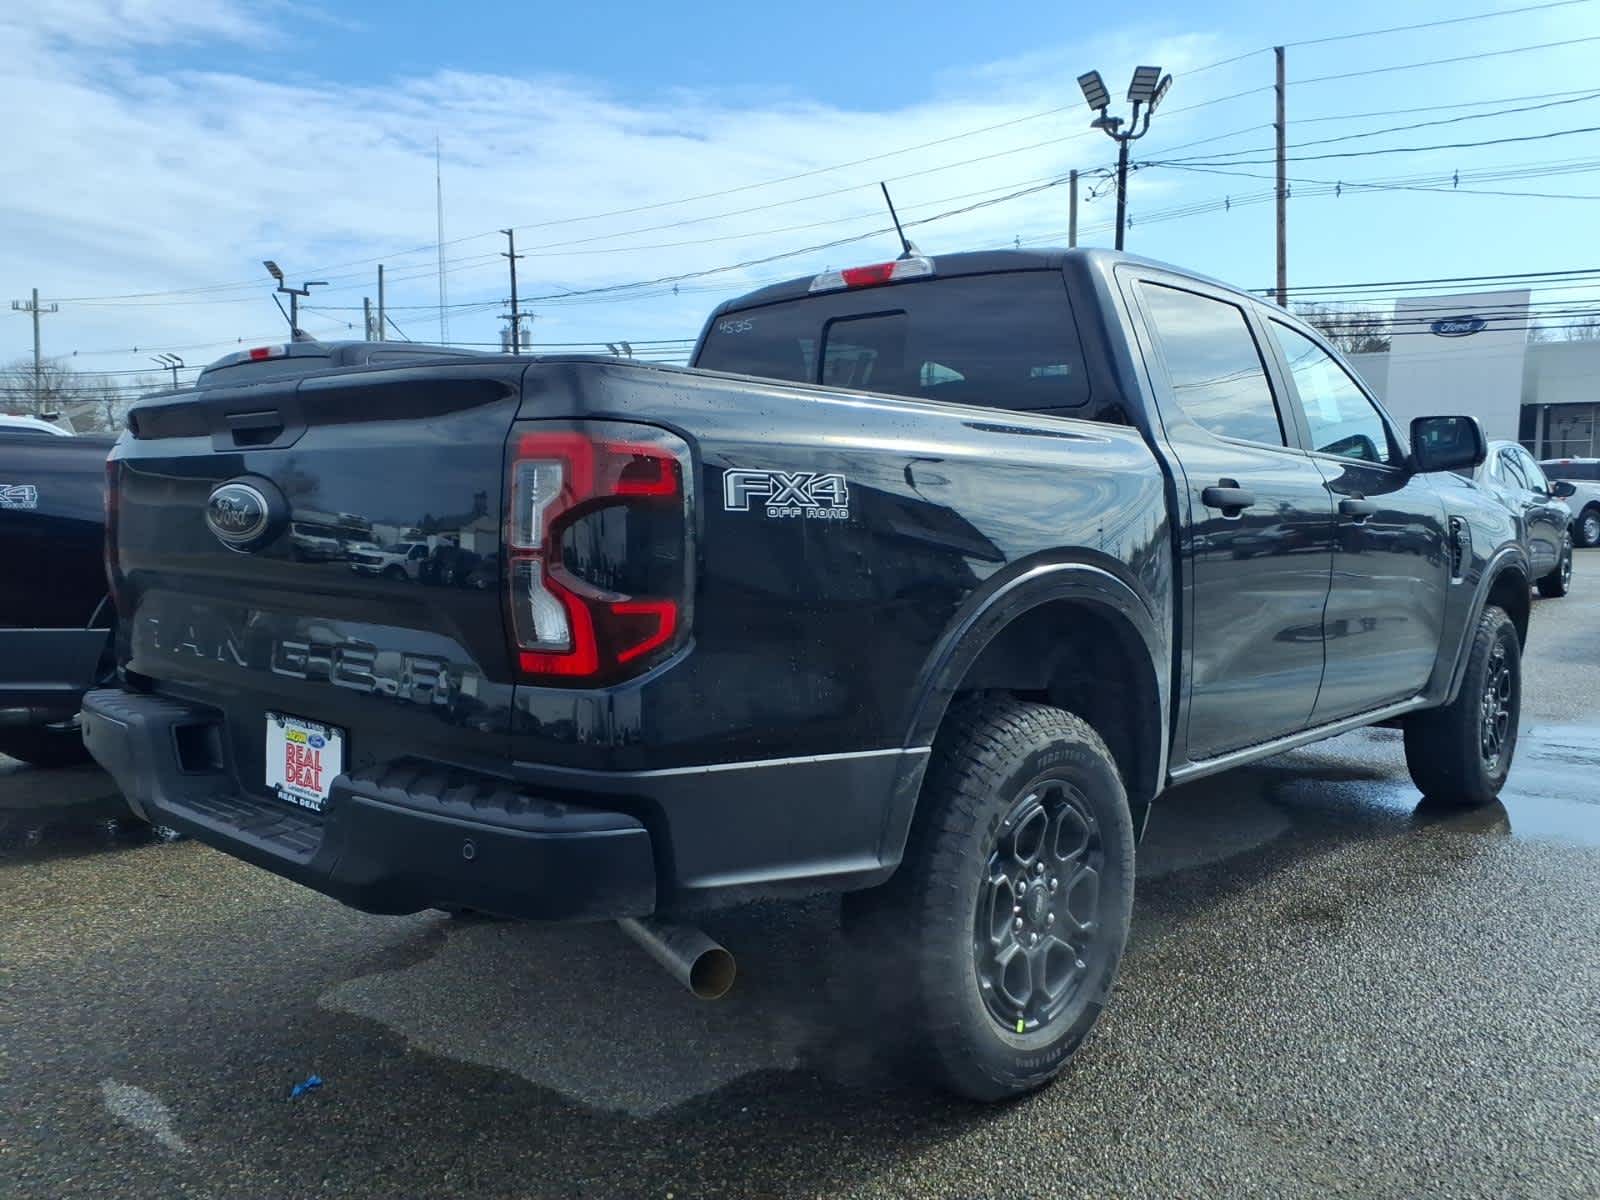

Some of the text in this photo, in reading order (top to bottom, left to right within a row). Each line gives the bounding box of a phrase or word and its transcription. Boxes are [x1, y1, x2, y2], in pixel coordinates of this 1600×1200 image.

[723, 468, 849, 511] FX4
[215, 495, 249, 526] Ford
[767, 506, 849, 519] OFF ROAD
[286, 742, 322, 771] REAL
[286, 762, 322, 792] DEAL
[278, 791, 321, 812] REAL DEAL
